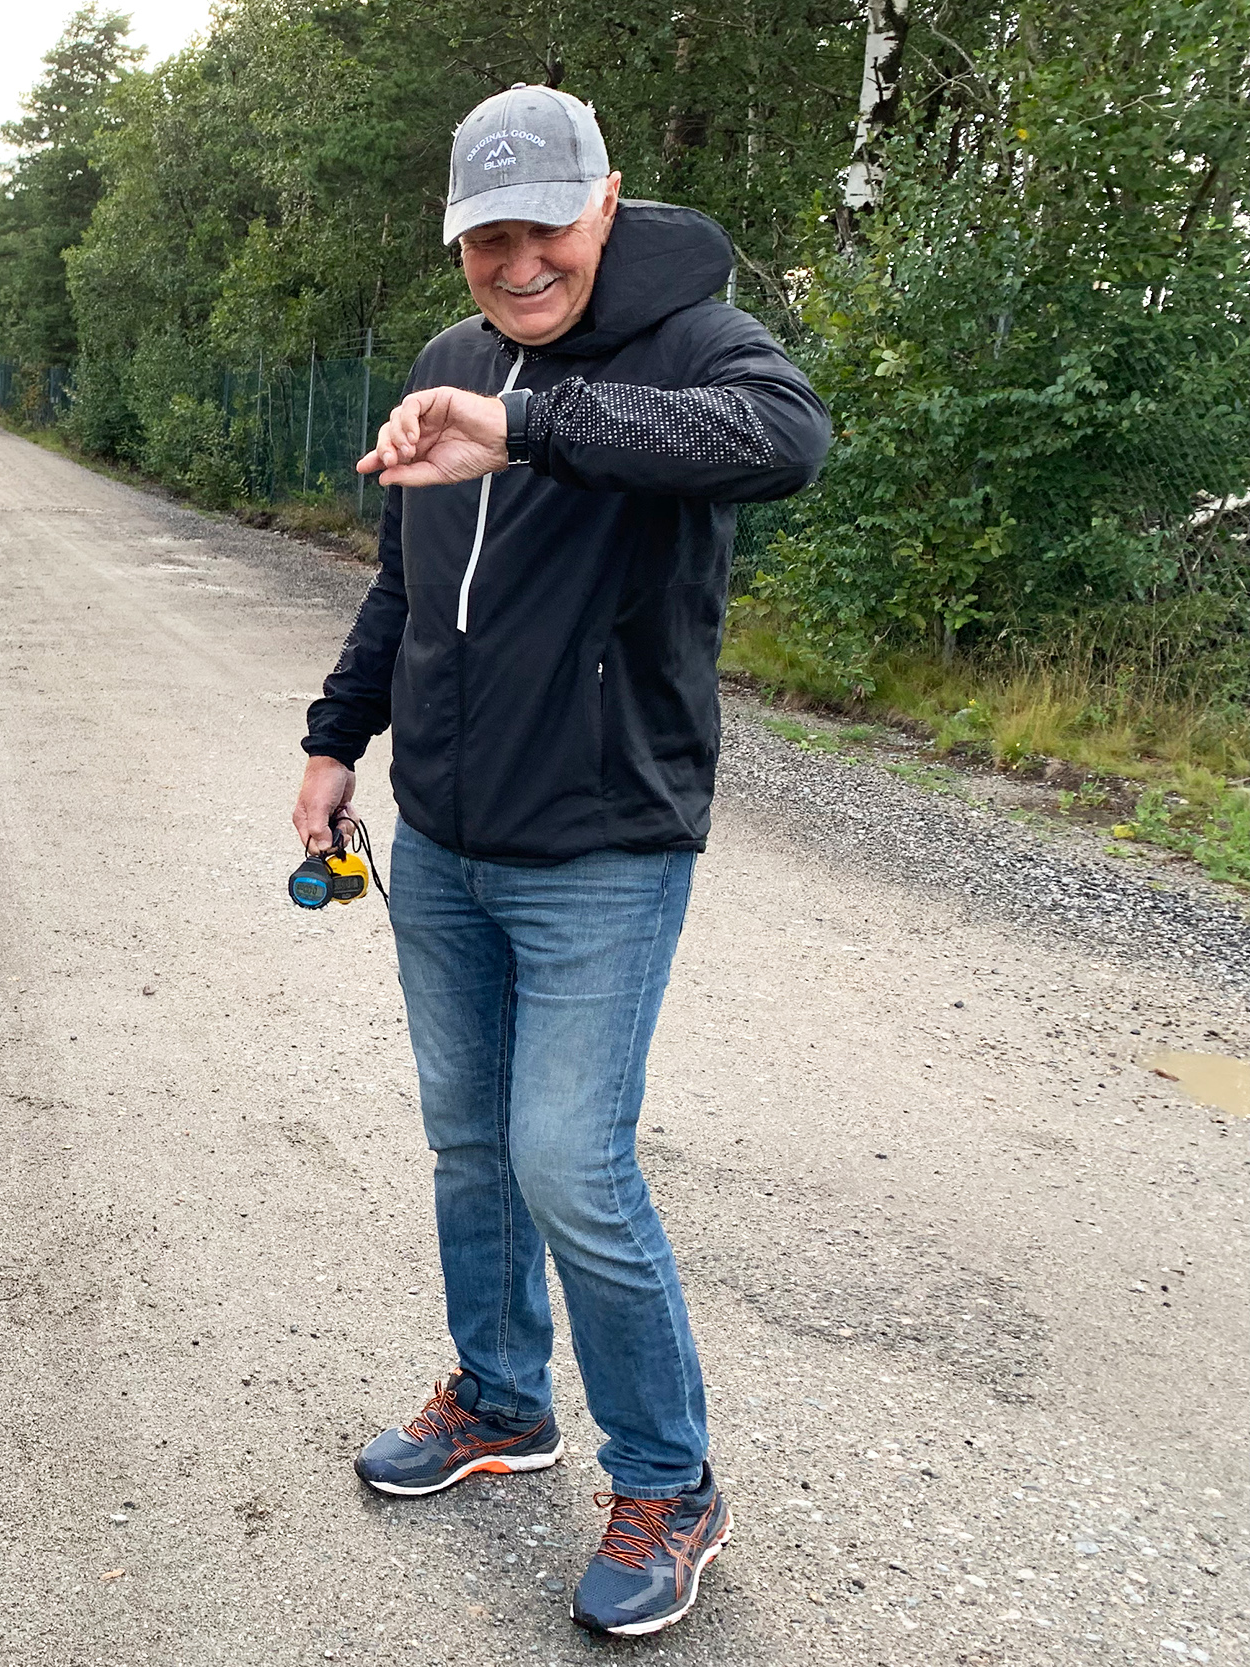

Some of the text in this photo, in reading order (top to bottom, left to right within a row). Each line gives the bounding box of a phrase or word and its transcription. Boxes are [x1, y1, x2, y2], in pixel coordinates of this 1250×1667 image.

[466, 129, 547, 162] ORIGINAL GOODS
[483, 156, 517, 171] BLWR
